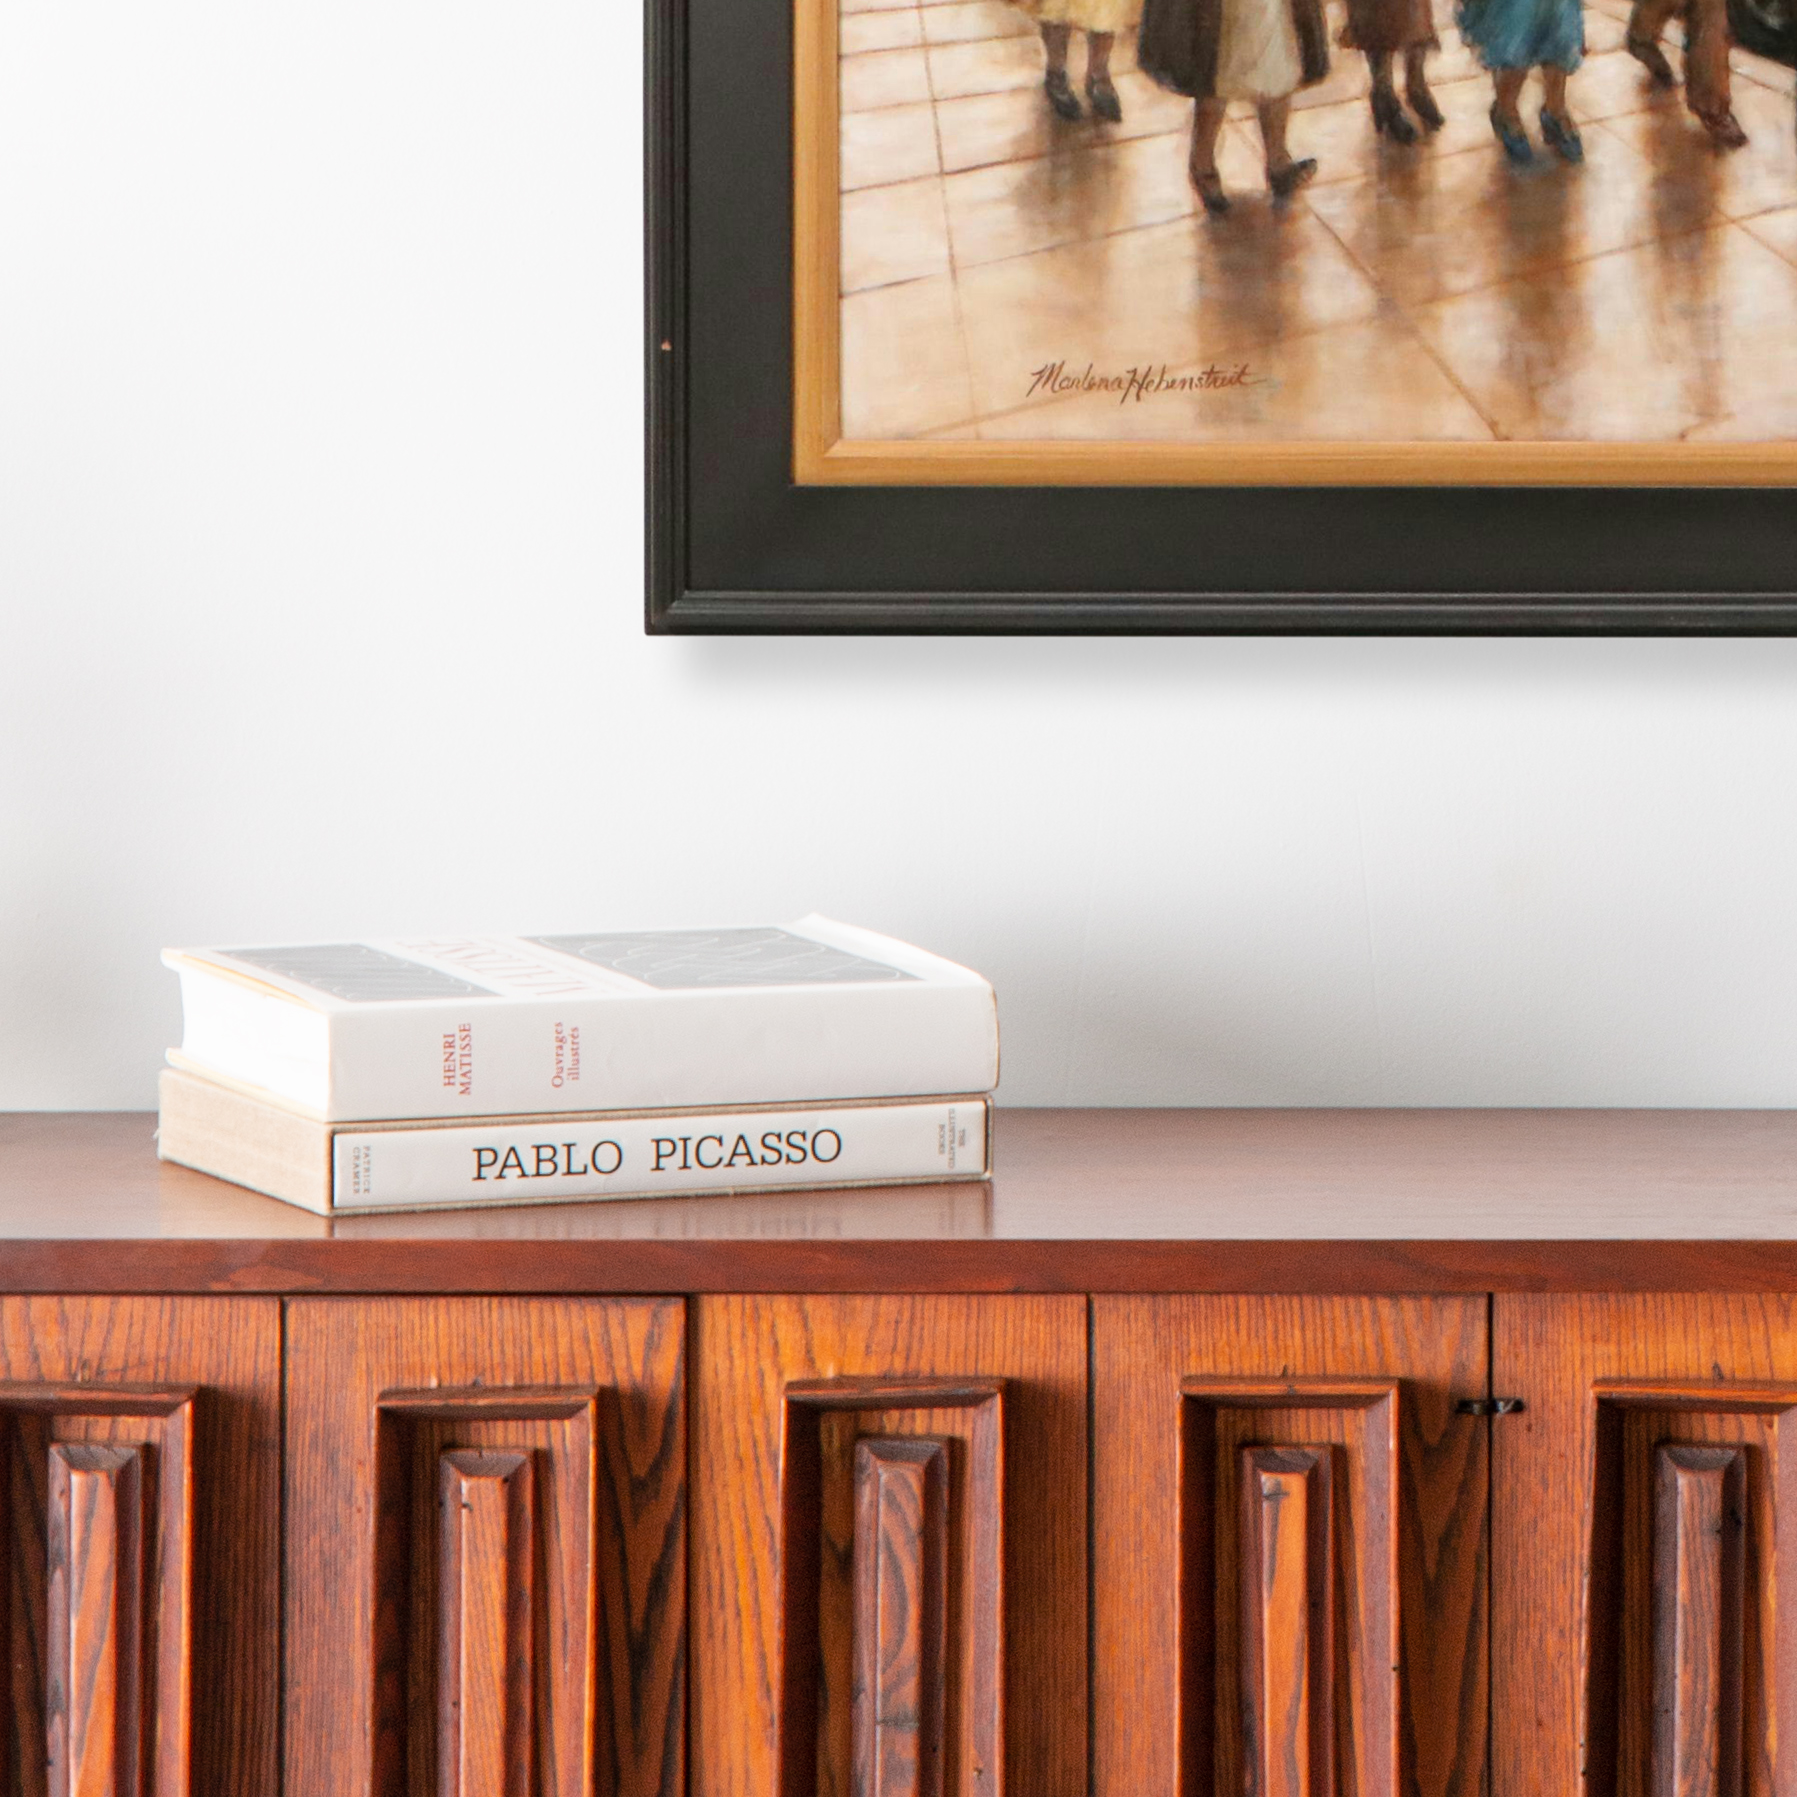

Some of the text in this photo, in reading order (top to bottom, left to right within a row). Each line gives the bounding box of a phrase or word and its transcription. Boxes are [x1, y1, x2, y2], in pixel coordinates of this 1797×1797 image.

[443, 1032, 456, 1087] HENRI
[458, 1022, 472, 1096] MATISSE
[551, 1021, 567, 1088] Ouvrages
[472, 1129, 842, 1181] PABLO PICASSO
